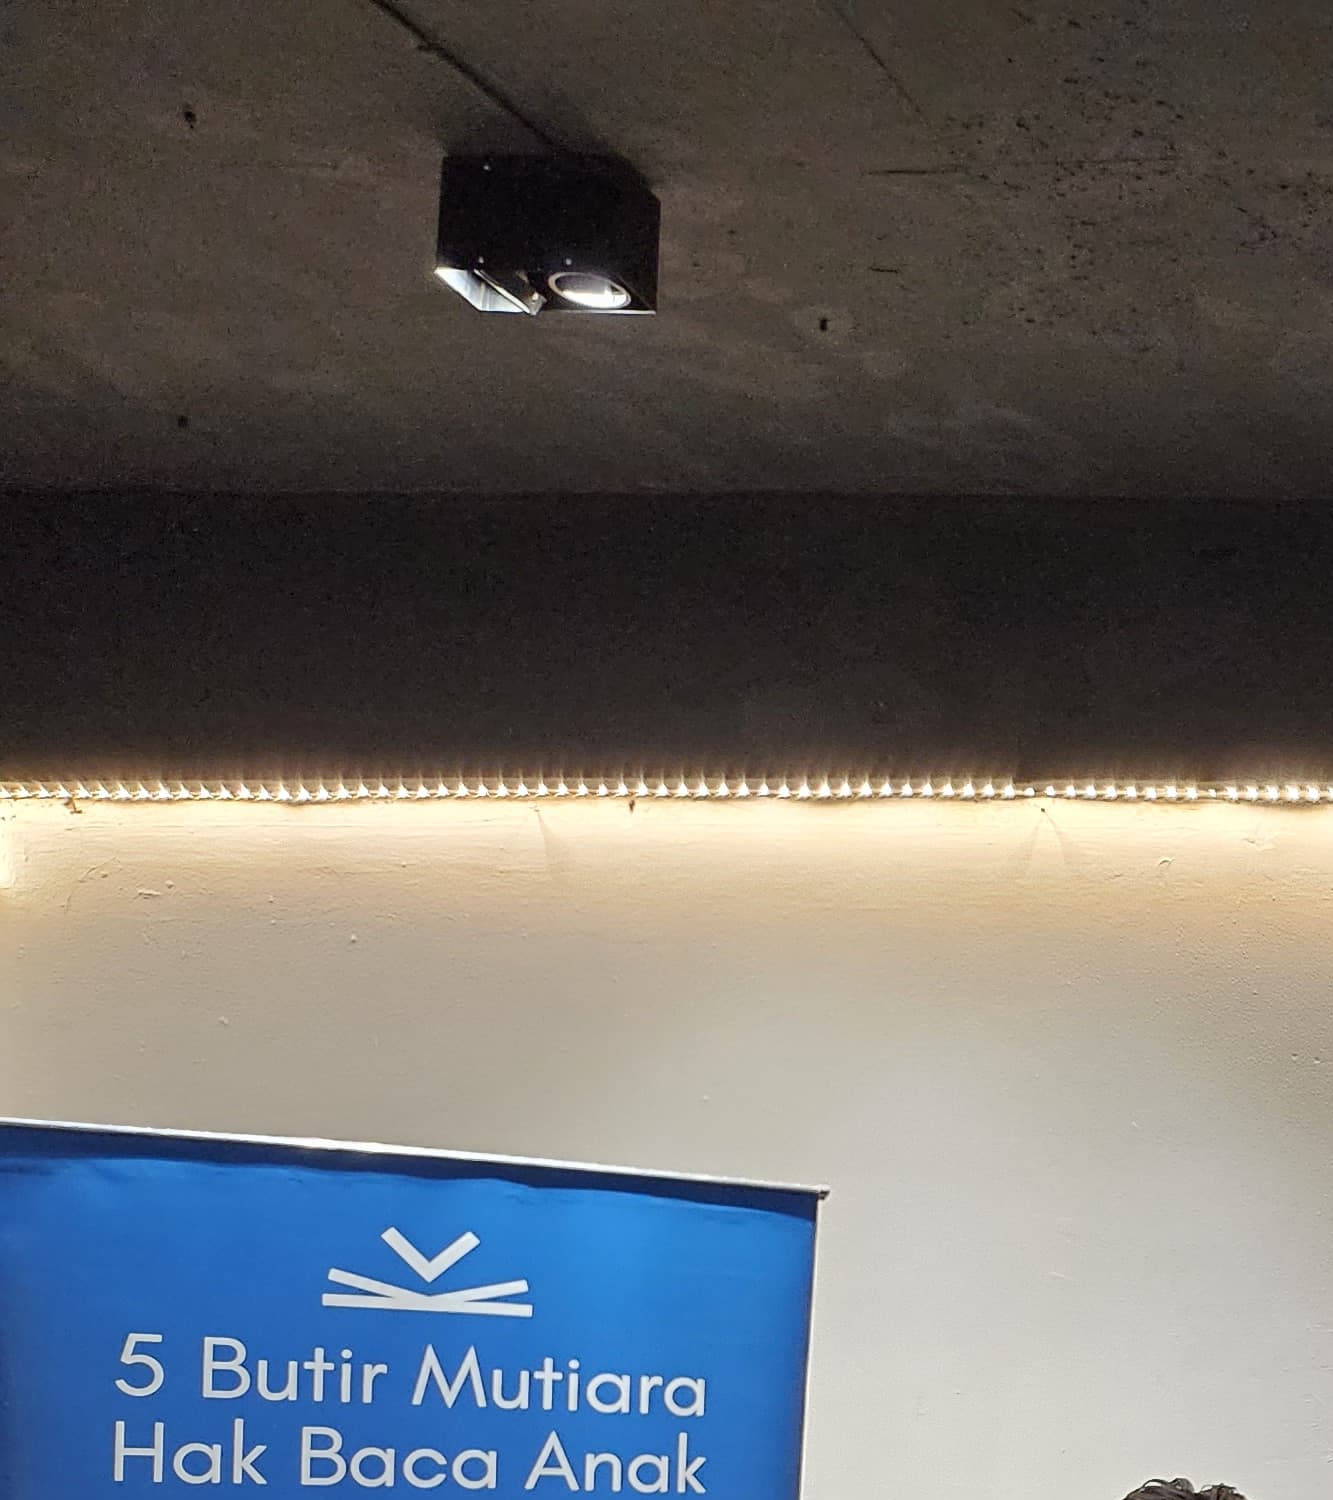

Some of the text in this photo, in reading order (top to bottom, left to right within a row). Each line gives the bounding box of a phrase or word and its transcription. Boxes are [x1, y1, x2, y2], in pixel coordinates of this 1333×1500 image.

[115, 1332, 706, 1417] 5 Butir Mutiara
[113, 1417, 707, 1494] Hak Baca Anak
